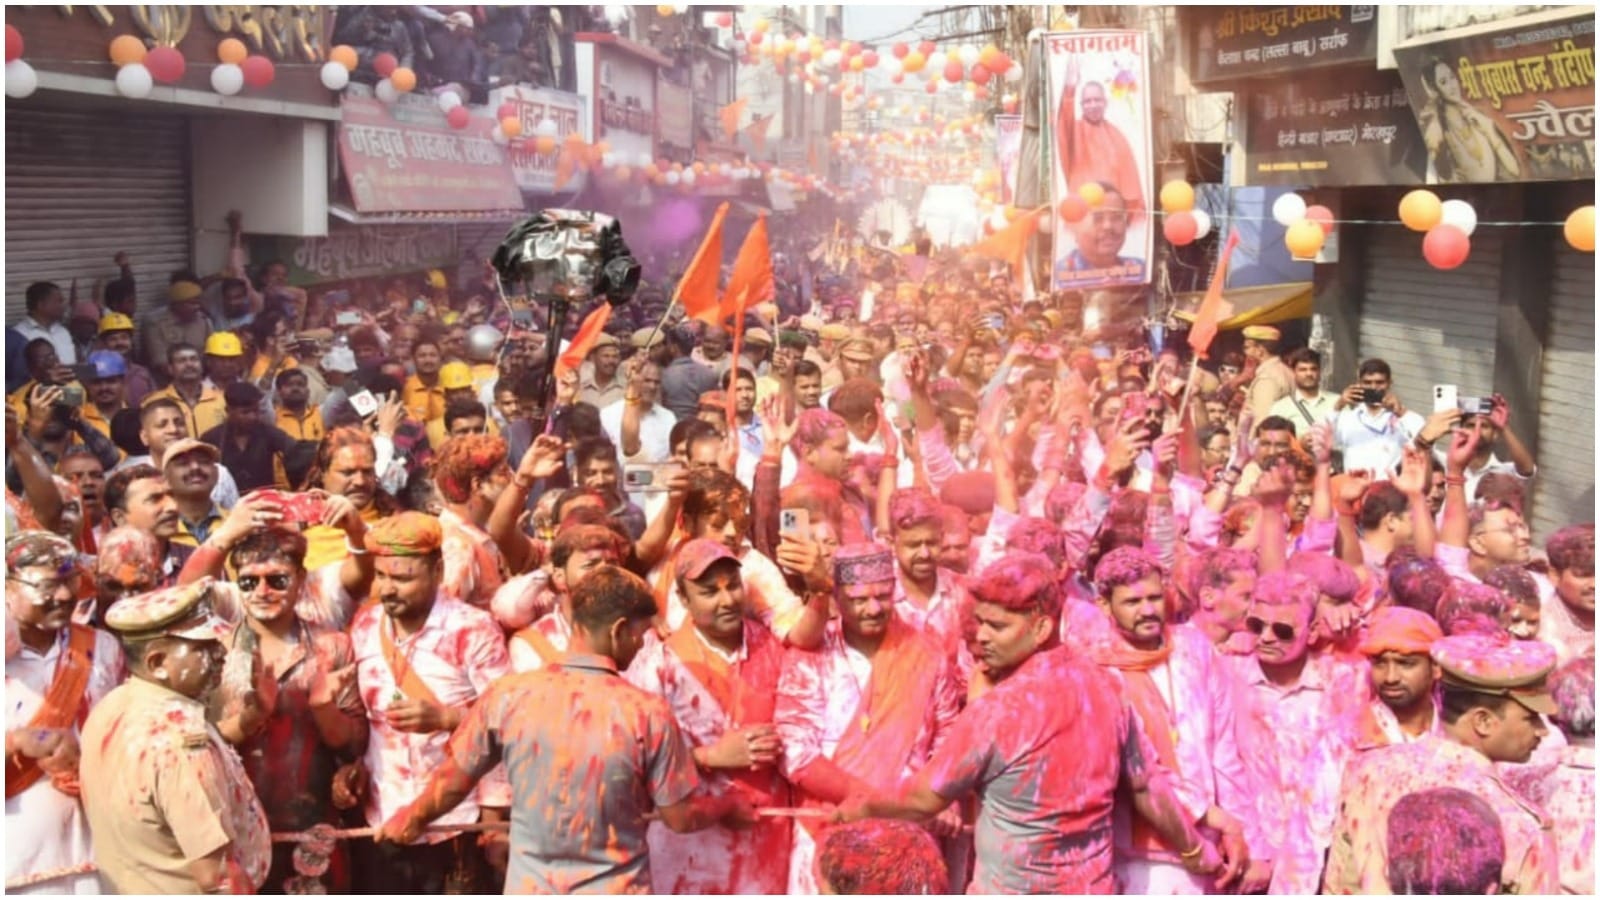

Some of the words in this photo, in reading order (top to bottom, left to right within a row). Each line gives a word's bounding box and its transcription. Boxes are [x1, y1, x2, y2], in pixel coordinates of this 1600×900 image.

[1216, 10, 1235, 39] श्री
[1047, 34, 1140, 56] स्वागतम्
[1458, 56, 1482, 99] श्री
